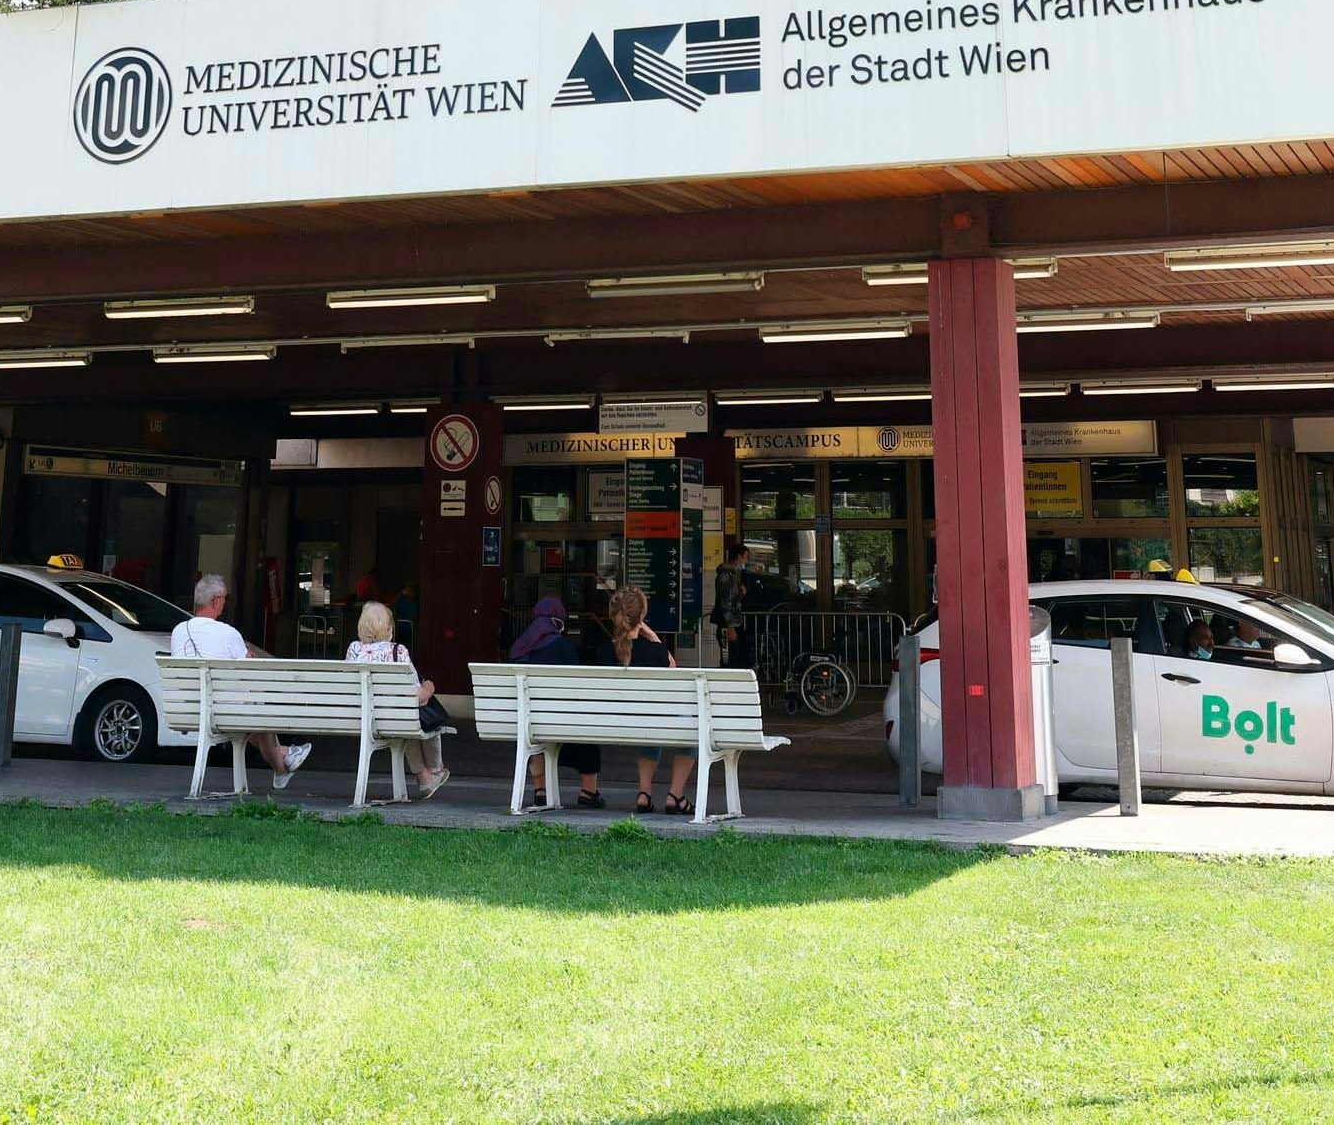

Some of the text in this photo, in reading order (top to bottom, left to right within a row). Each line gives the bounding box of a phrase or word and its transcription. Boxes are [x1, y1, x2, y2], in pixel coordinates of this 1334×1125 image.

[183, 43, 442, 95] MEDIZINISCHE
[782, 44, 1051, 90] der Stadt Wien
[182, 79, 528, 136] UNIVERSITÄT WIEN
[903, 431, 933, 439] MEDIZI
[1030, 427, 1121, 440] Allgemeines Krankenhaus
[526, 437, 651, 453] MEDIZINISCHER
[903, 440, 934, 448] UNIVER
[1043, 438, 1064, 446] Stadt
[1065, 438, 1082, 446] Wien
[107, 461, 164, 476] Michelbeuern
[1028, 470, 1057, 480] Eingang
[1203, 694, 1296, 755] Bolt
